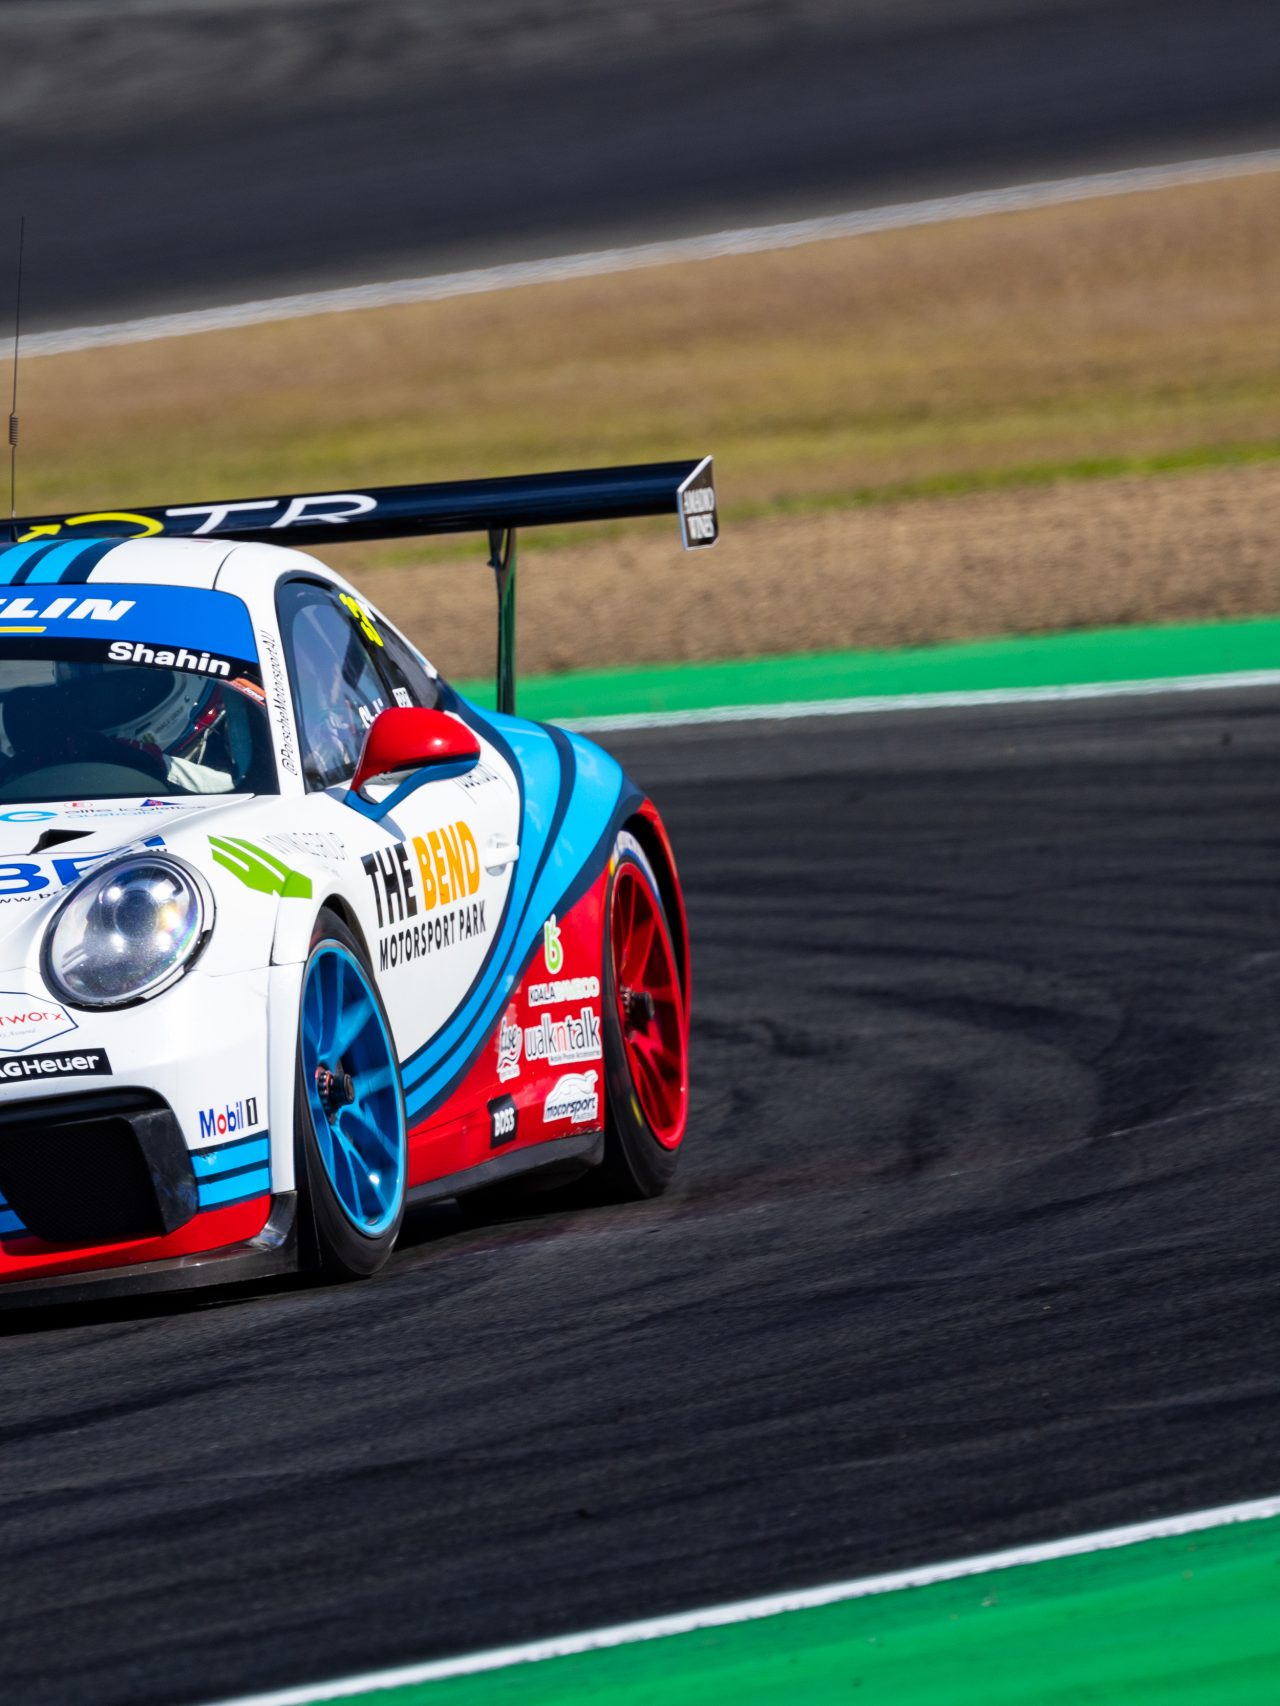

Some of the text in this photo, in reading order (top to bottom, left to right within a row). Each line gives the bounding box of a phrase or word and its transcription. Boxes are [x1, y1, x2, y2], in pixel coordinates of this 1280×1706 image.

[107, 642, 231, 676] Shahin
[360, 821, 480, 928] THE BEND
[380, 899, 486, 972] MOTORSPORT PARK
[525, 1009, 600, 1058] walkntalk
[199, 1096, 259, 1139] Mobil 1
[493, 1106, 516, 1137] BOSS
